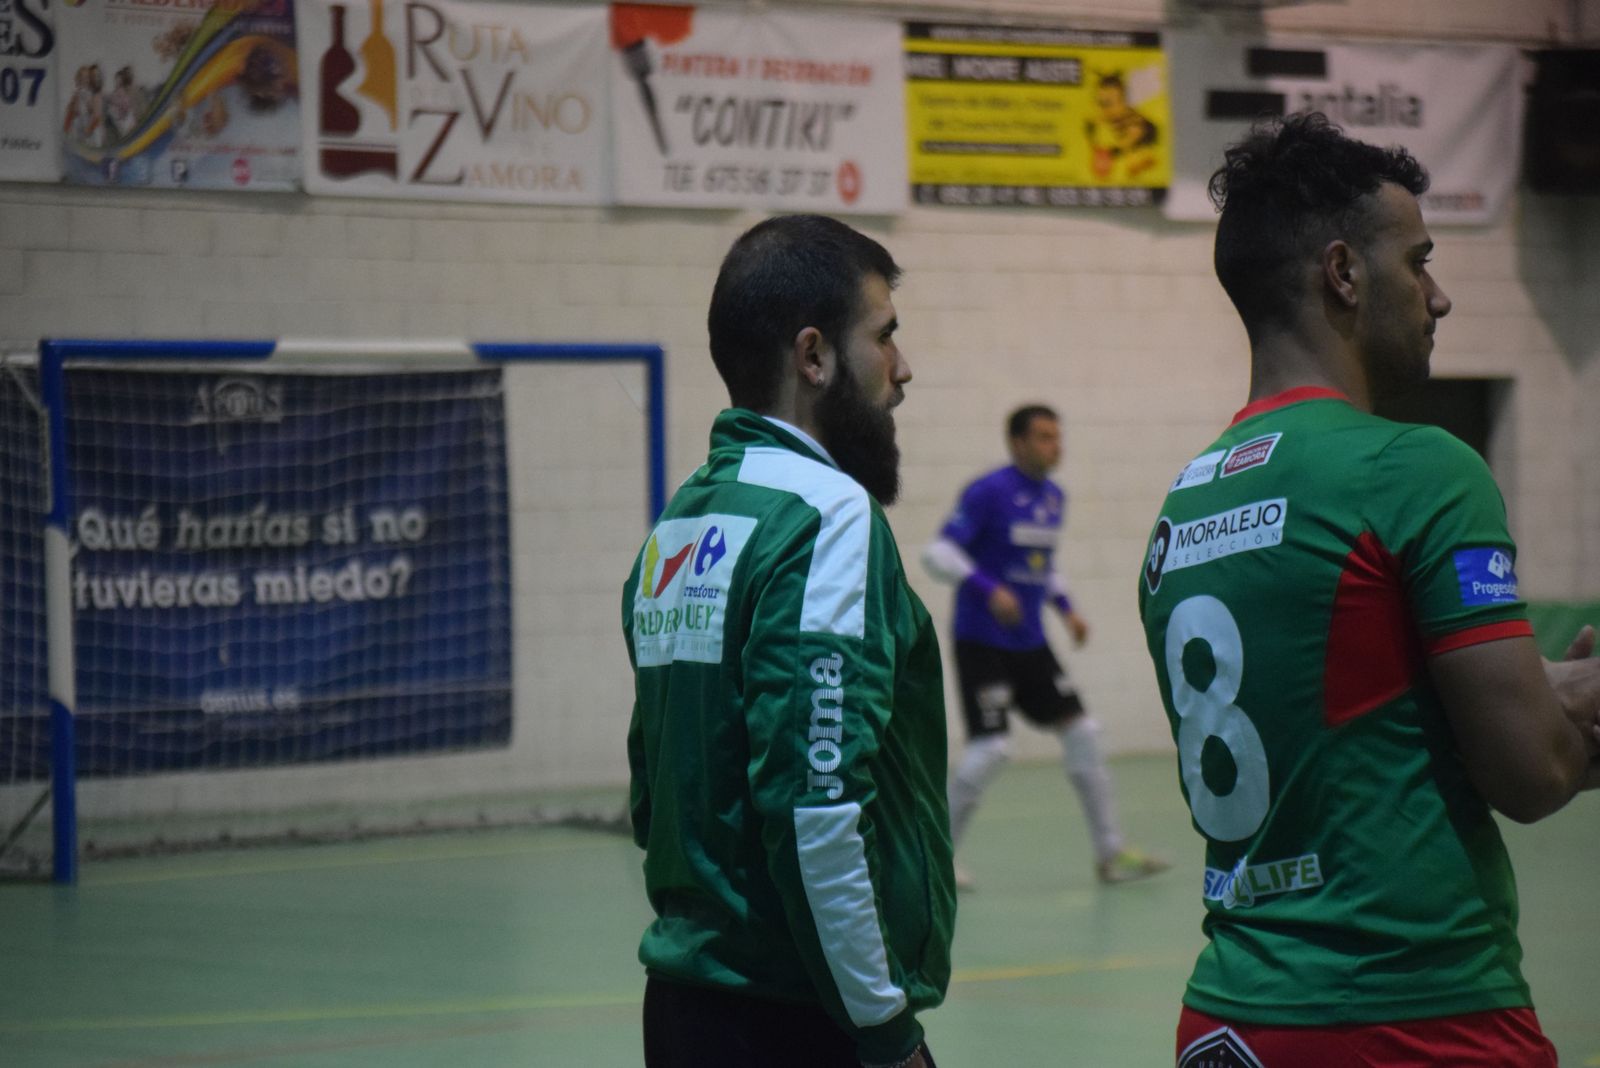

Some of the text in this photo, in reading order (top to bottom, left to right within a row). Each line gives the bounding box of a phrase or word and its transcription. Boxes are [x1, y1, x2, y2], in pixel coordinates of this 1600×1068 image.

[404, 3, 530, 83] RUTA
[1, 67, 46, 107] 07
[459, 68, 590, 142] VINO
[408, 108, 586, 187] ZAMORA
[71, 503, 428, 556] Qué harías si no
[1175, 503, 1282, 551] MORALEJO
[75, 554, 411, 610] tuvieras miedo?
[1165, 595, 1270, 842] 8
